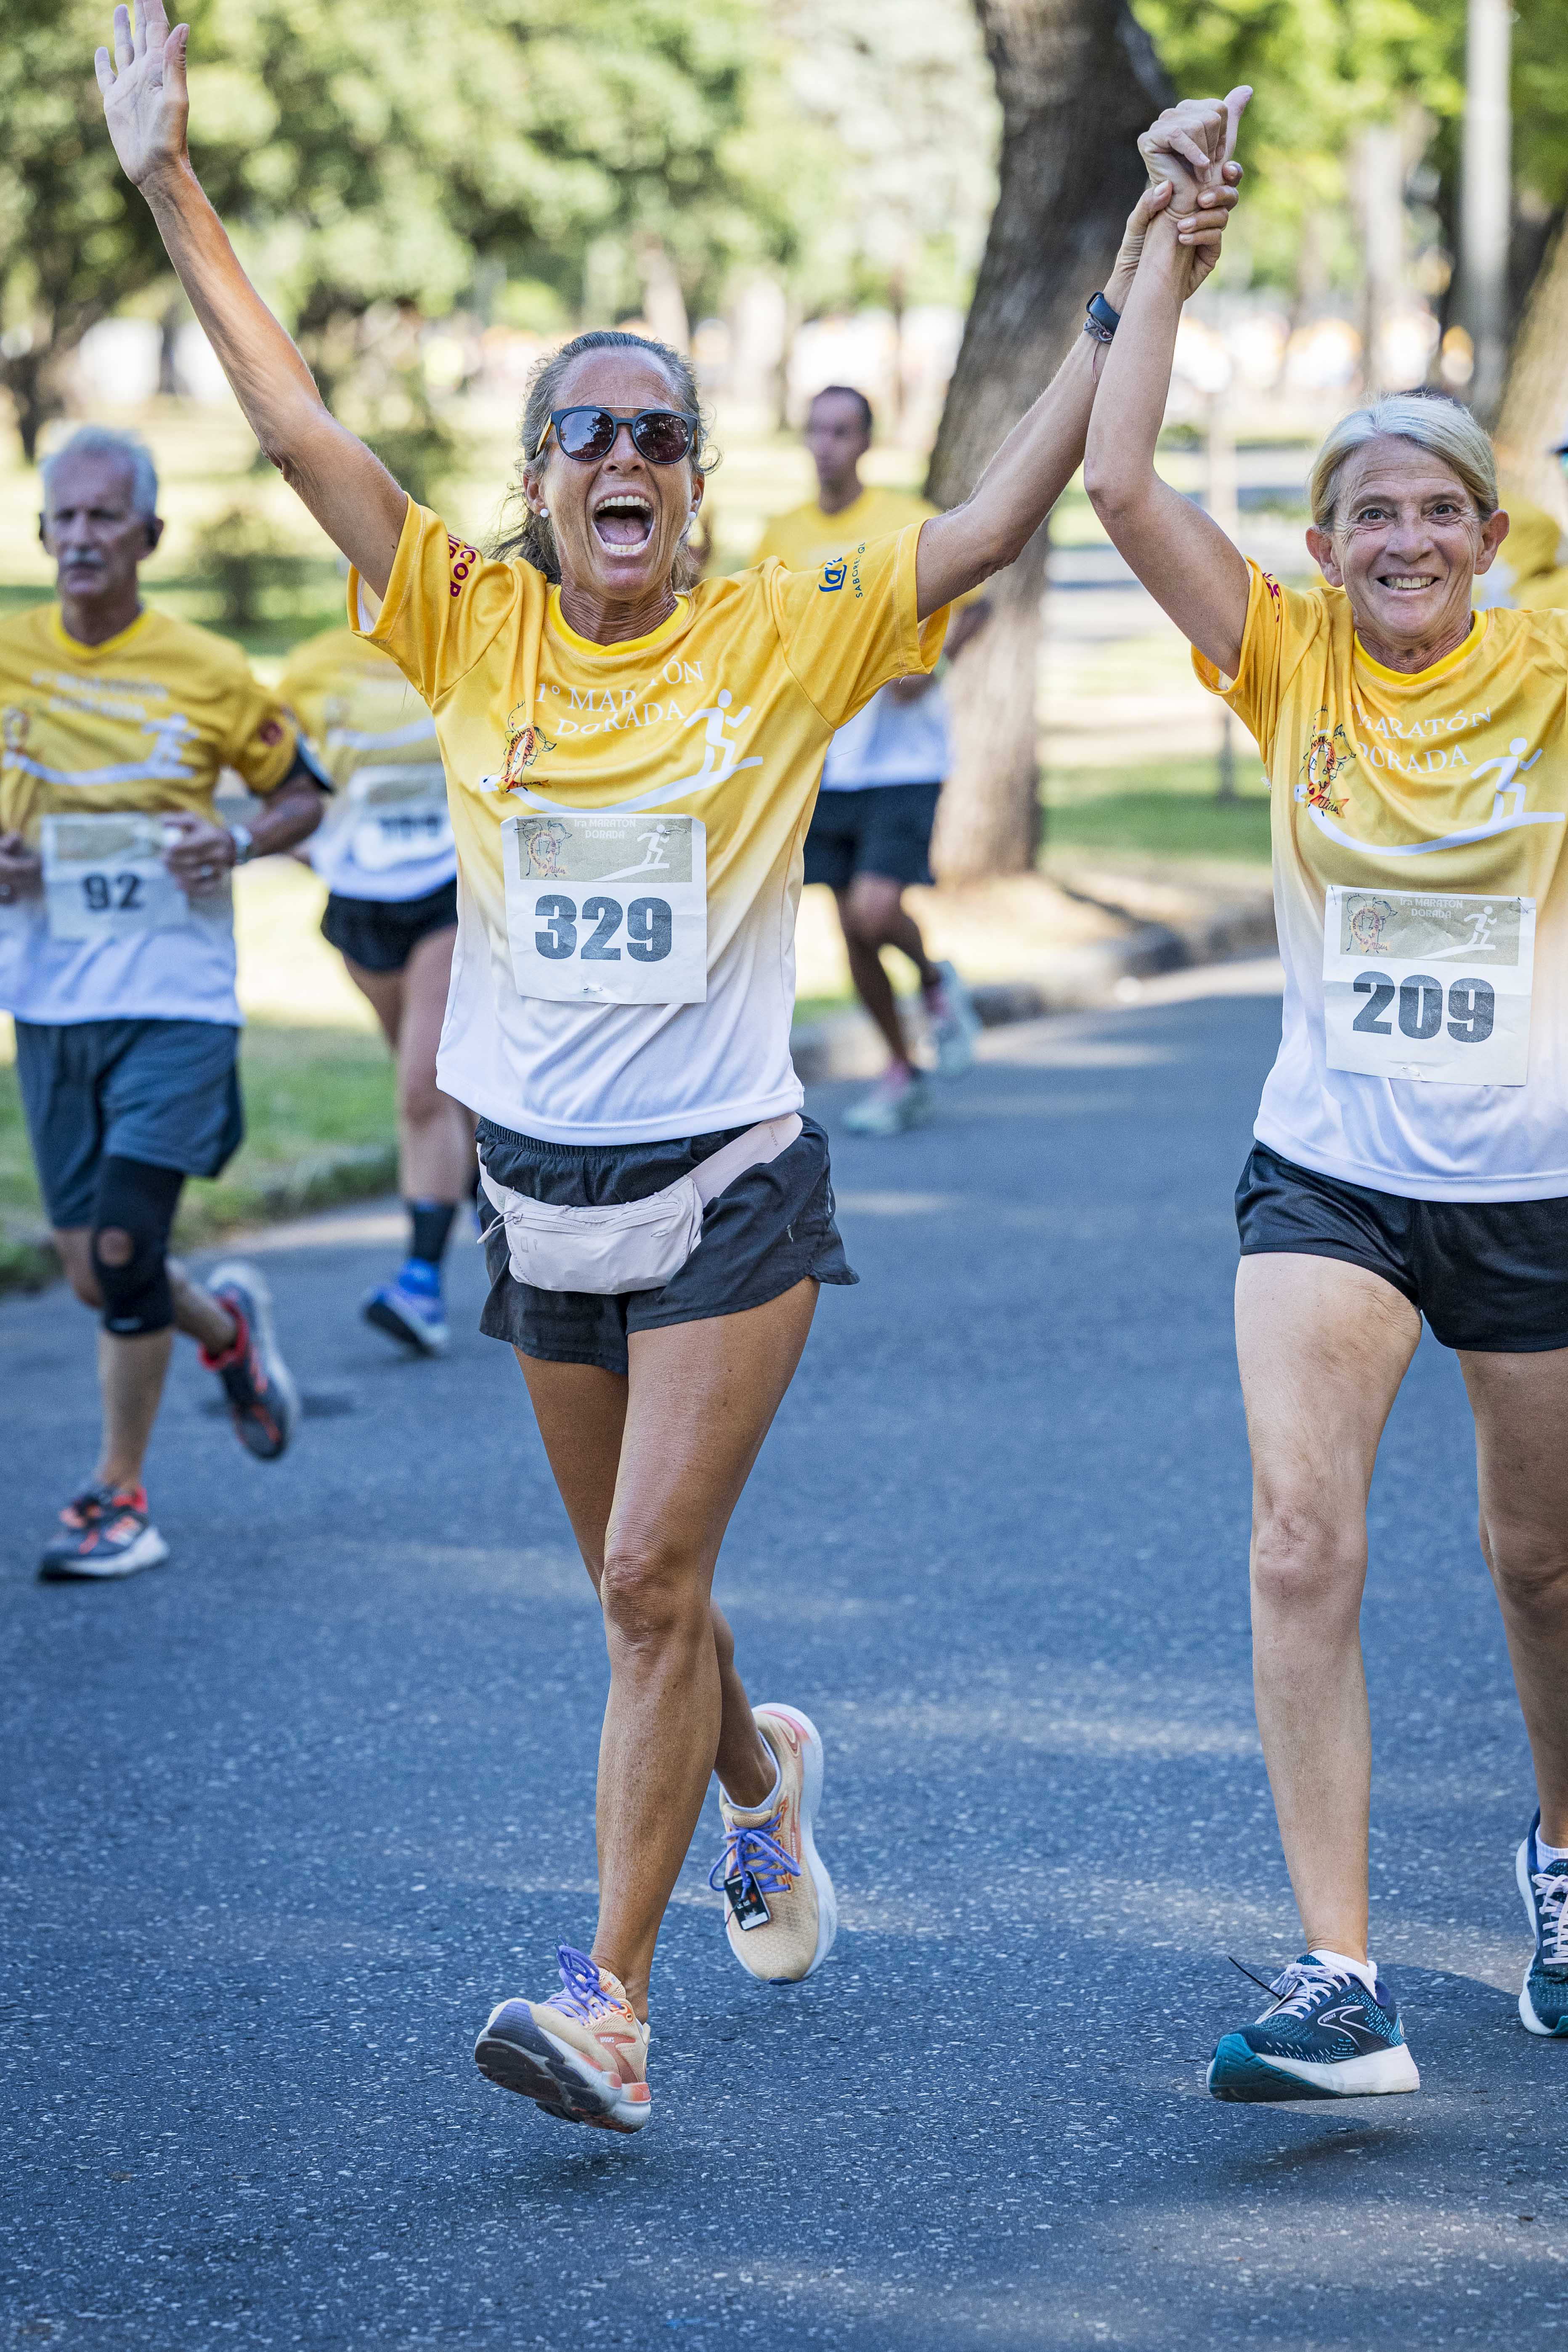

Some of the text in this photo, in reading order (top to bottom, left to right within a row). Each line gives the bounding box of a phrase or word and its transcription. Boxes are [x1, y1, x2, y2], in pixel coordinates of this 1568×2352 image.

[852, 555, 863, 598] SABORE
[568, 655, 704, 712] MARÓN
[554, 700, 687, 735] DORADA
[585, 830, 625, 839] DORADA
[535, 895, 672, 962] 329
[1411, 908, 1451, 918] DORADA
[1353, 971, 1495, 1043] 209
